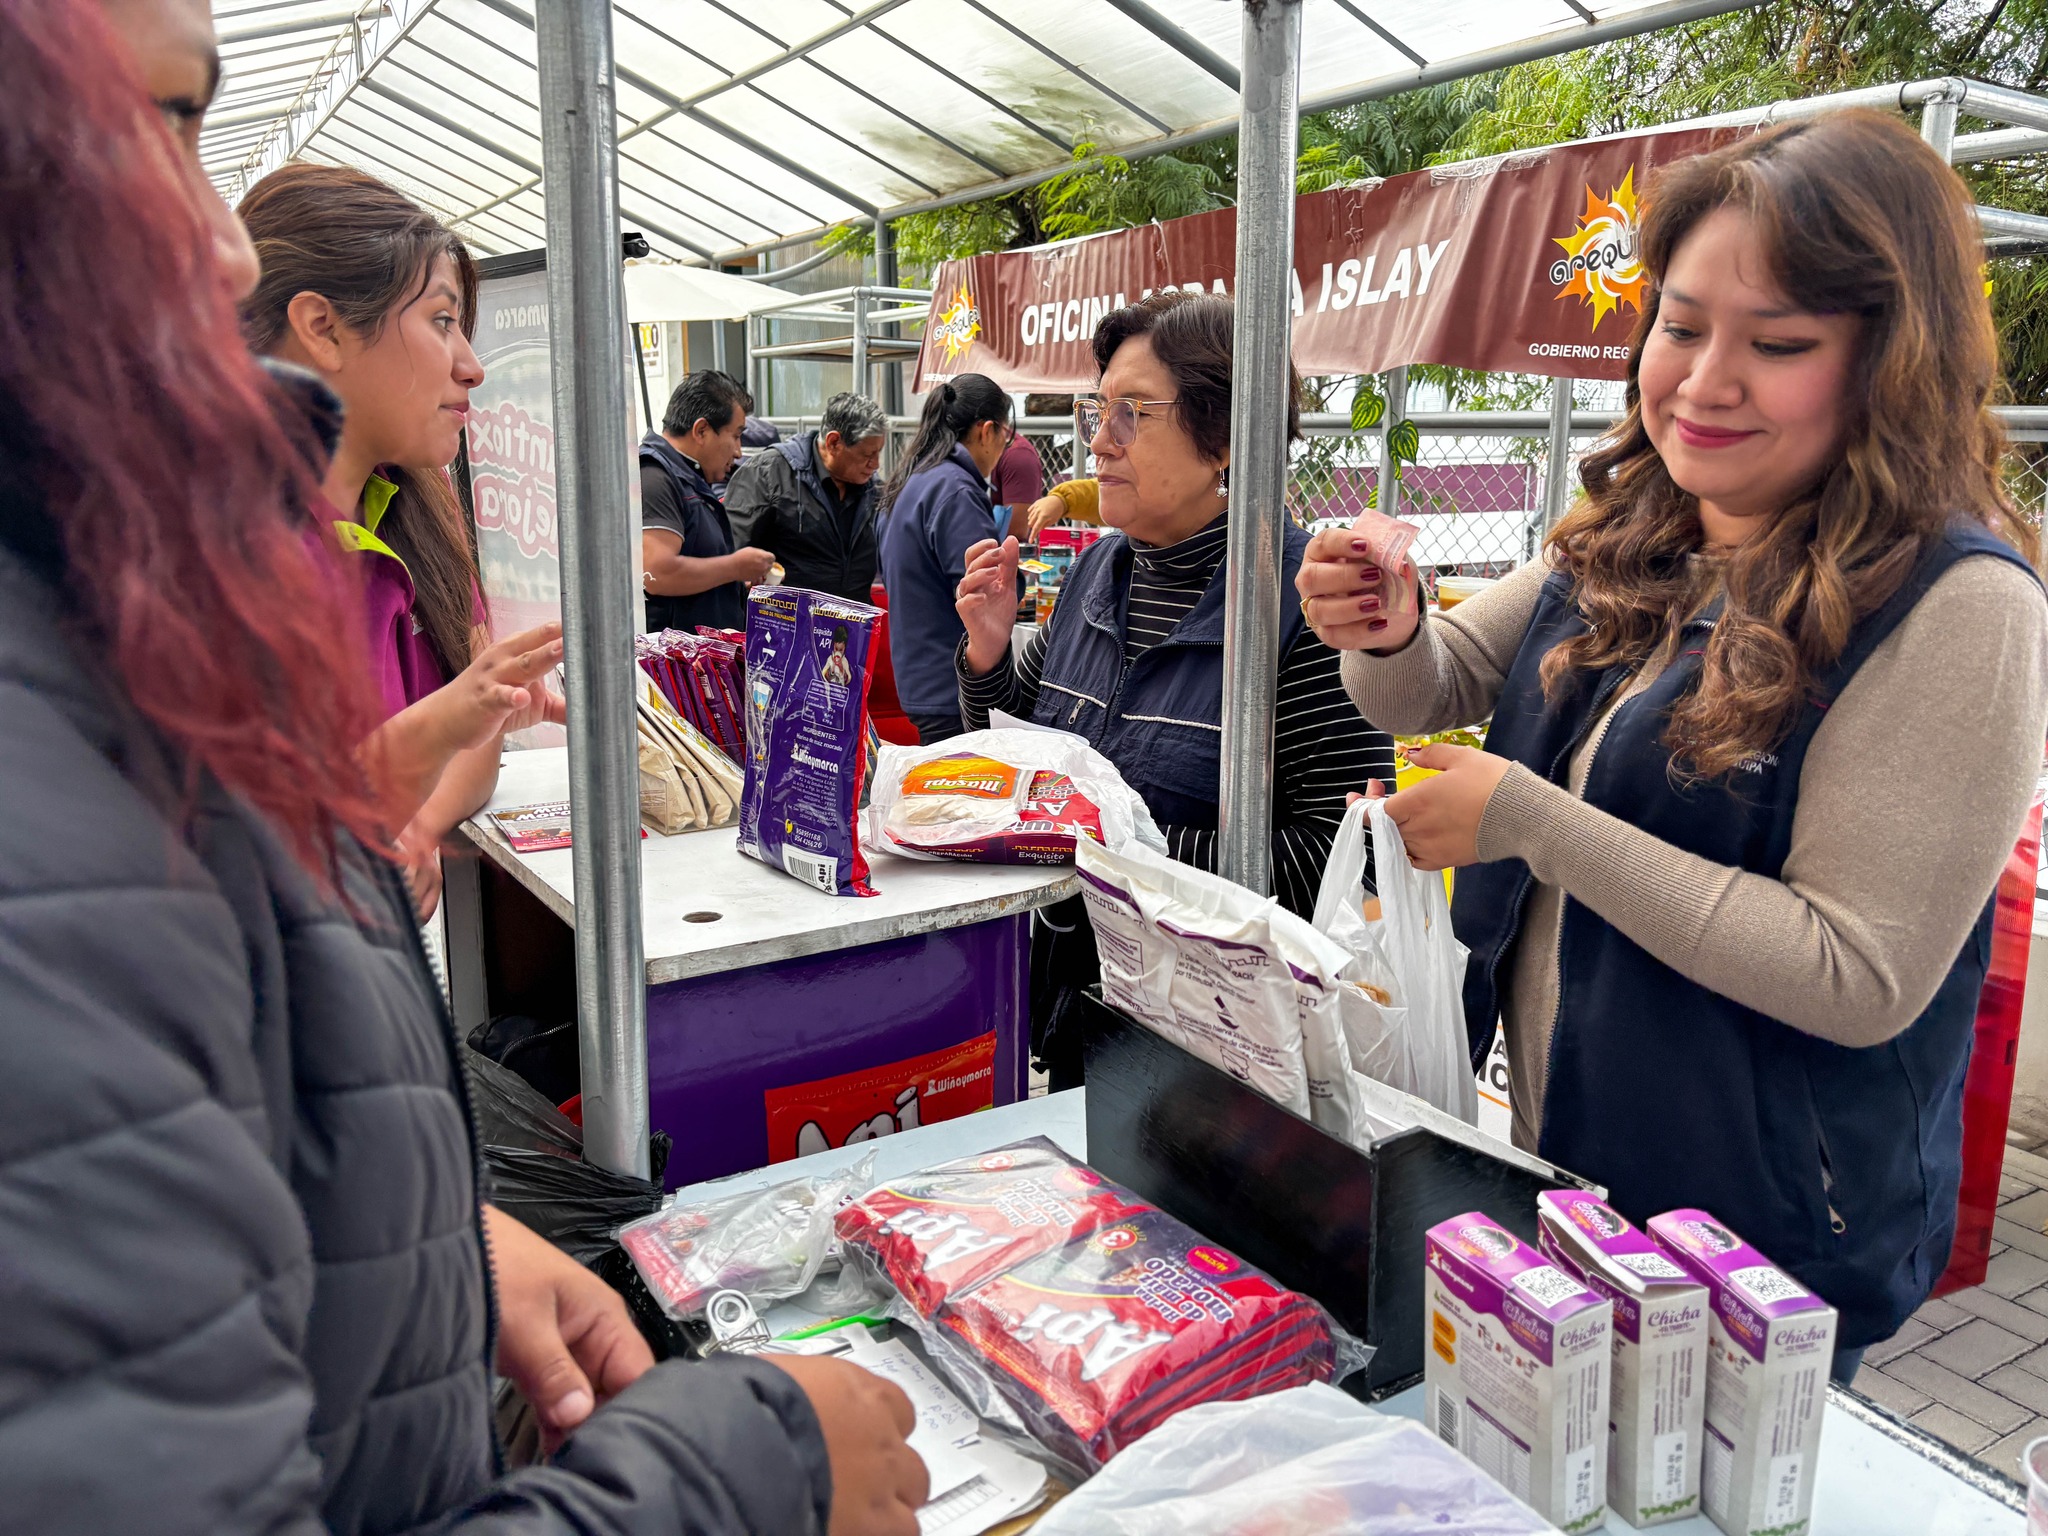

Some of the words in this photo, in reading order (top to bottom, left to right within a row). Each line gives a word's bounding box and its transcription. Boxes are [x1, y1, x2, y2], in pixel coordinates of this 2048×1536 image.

[1317, 239, 1450, 314] ISLAY
[1528, 342, 1600, 359] GOBIERNO
[1603, 346, 1629, 360] REG
[820, 638, 832, 649] API
[924, 778, 1001, 793] Masapi
[516, 810, 571, 822] Mora
[1019, 851, 1065, 861] Exquisito
[818, 863, 827, 883] Api
[937, 1066, 992, 1093] Wiñaymarca
[877, 1208, 1013, 1272] Api
[1101, 1230, 1130, 1247] 3
[1136, 1273, 1184, 1305] maíz
[1144, 1257, 1235, 1325] morado
[1133, 1287, 1182, 1324] Harina
[1178, 1301, 1206, 1322] de
[1648, 1305, 1701, 1327] Chicha
[1720, 1293, 1763, 1339] Chicha
[1502, 1300, 1549, 1343] Chicha
[1015, 1303, 1173, 1382] Api
[1560, 1320, 1606, 1348] Chicha
[1774, 1325, 1827, 1346] Chicha
